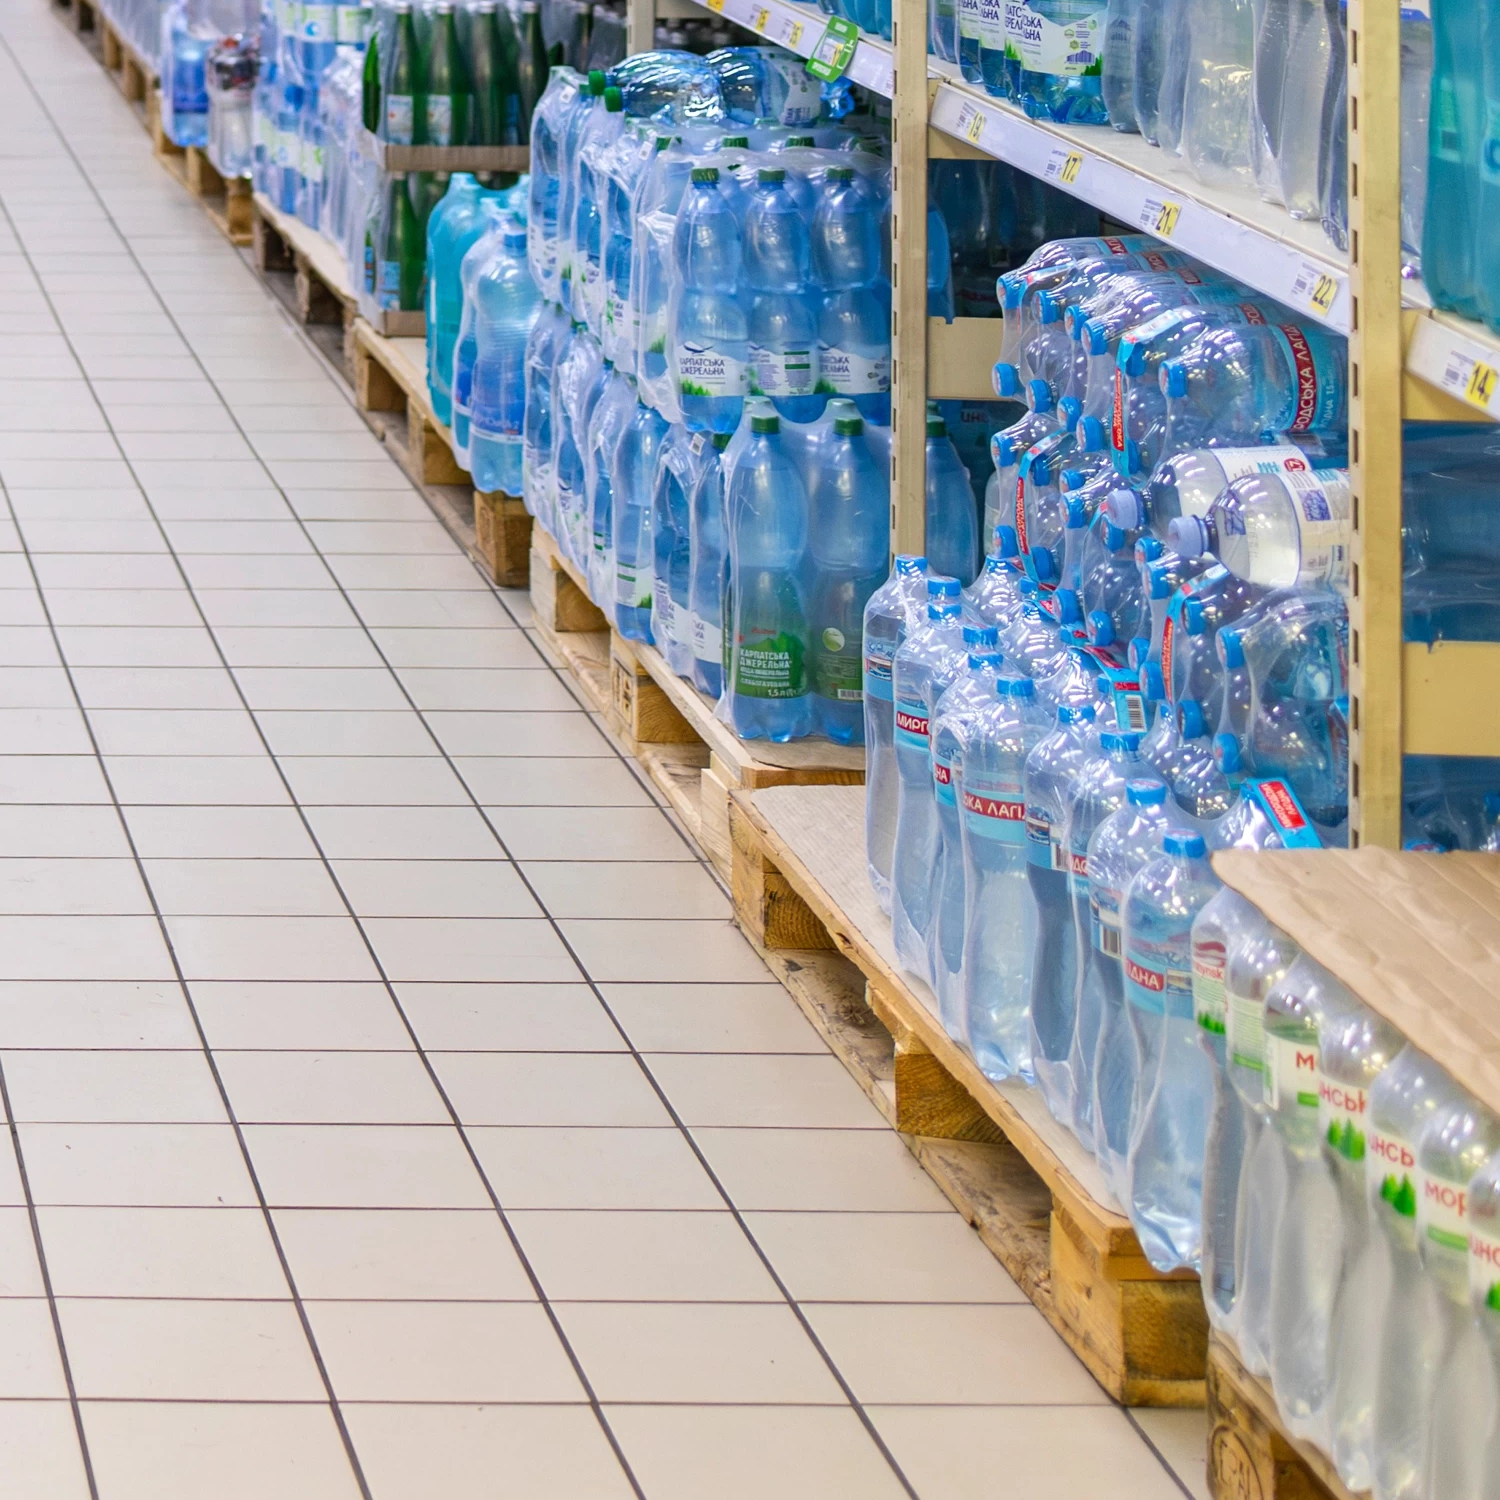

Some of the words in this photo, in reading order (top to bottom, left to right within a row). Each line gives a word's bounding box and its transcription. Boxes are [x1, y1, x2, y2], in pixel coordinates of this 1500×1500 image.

[1156, 205, 1173, 234] 21
[1312, 275, 1332, 306] 22
[1469, 364, 1490, 398] 14
[896, 712, 929, 732] МИРГ
[987, 801, 1024, 820] ЛАГІ
